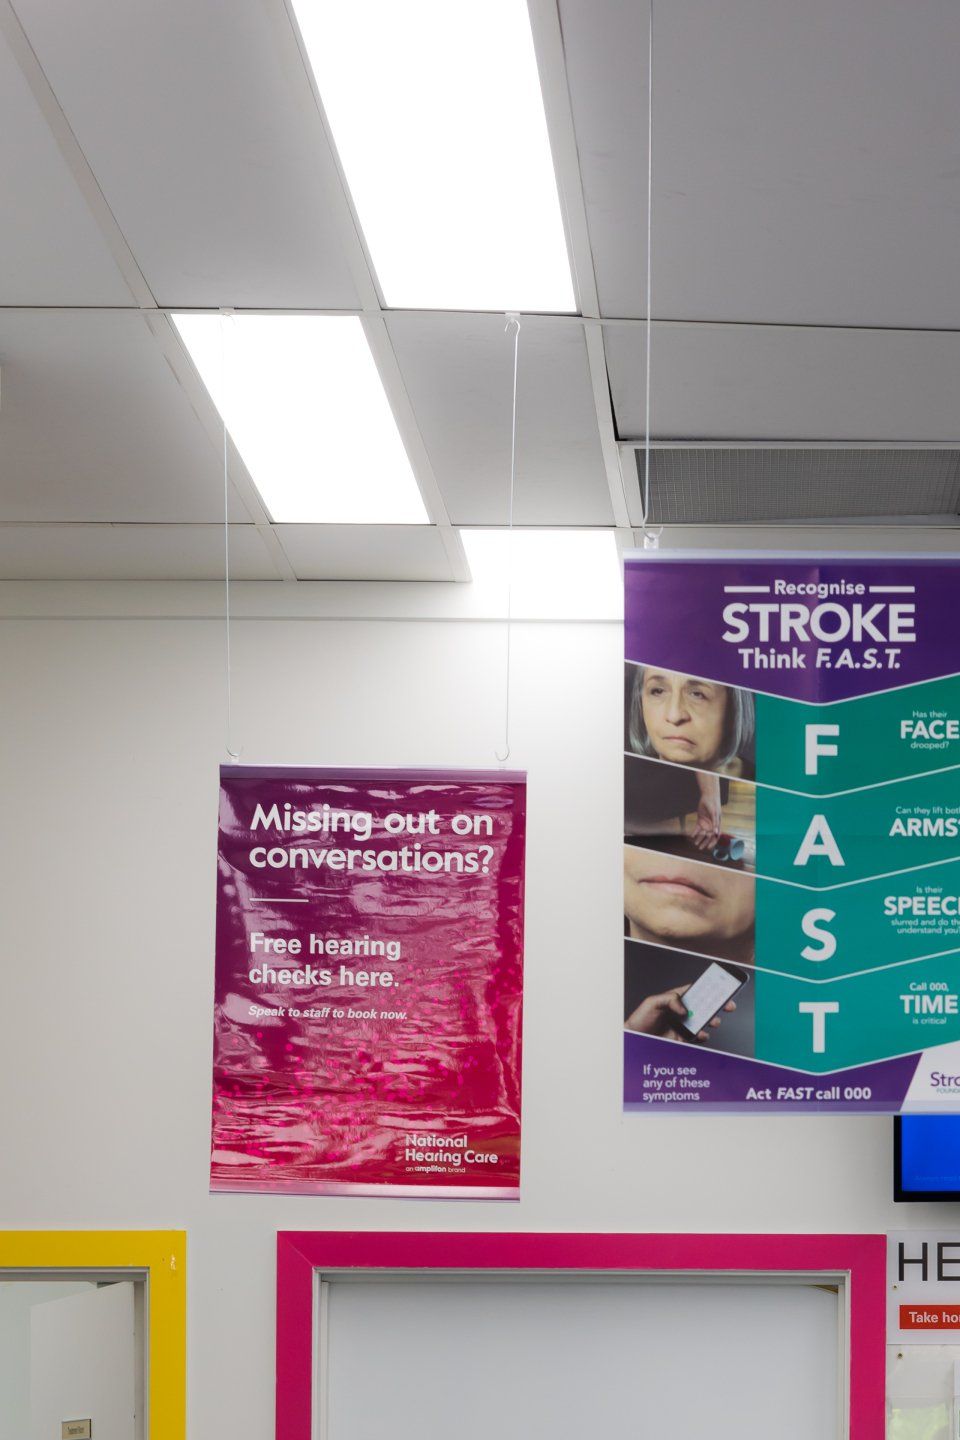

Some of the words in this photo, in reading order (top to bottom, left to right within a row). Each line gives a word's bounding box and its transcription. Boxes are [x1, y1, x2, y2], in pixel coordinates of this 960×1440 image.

[774, 580, 865, 599] Recognise
[722, 602, 916, 642] STROKE
[738, 648, 806, 669] Think
[816, 648, 901, 669] F.A.S.T.
[900, 720, 959, 740] FACE
[805, 724, 840, 775] F
[250, 803, 372, 840] Missing
[384, 810, 440, 834] out
[452, 814, 493, 836] on
[793, 815, 845, 866] A
[249, 843, 494, 873] conversations?
[800, 908, 836, 961] S
[250, 933, 301, 954] Free
[309, 934, 401, 960] hearing
[249, 964, 331, 986] checks
[339, 967, 399, 987] here.
[909, 982, 927, 991] Call
[930, 982, 949, 993] 000,
[249, 1006, 286, 1018] Speak
[288, 1008, 300, 1017] to
[303, 1006, 330, 1018] staff
[333, 1008, 344, 1018] to
[348, 1008, 377, 1019] book
[380, 1011, 407, 1019] now.
[900, 995, 958, 1013] TIME
[799, 1002, 839, 1053] T
[643, 1065, 650, 1076] If
[653, 1067, 674, 1078] you
[677, 1067, 696, 1076] see
[643, 1079, 660, 1090] any
[662, 1077, 675, 1087] of
[679, 1077, 710, 1088] these
[746, 1088, 771, 1099] Act
[777, 1088, 814, 1099] FAST
[815, 1087, 840, 1099] call
[844, 1087, 871, 1099] 000
[643, 1090, 700, 1102] symptoms
[406, 1134, 467, 1147] National
[406, 1150, 461, 1164] Hearing
[464, 1151, 498, 1163] Care
[909, 1311, 938, 1323] Take
